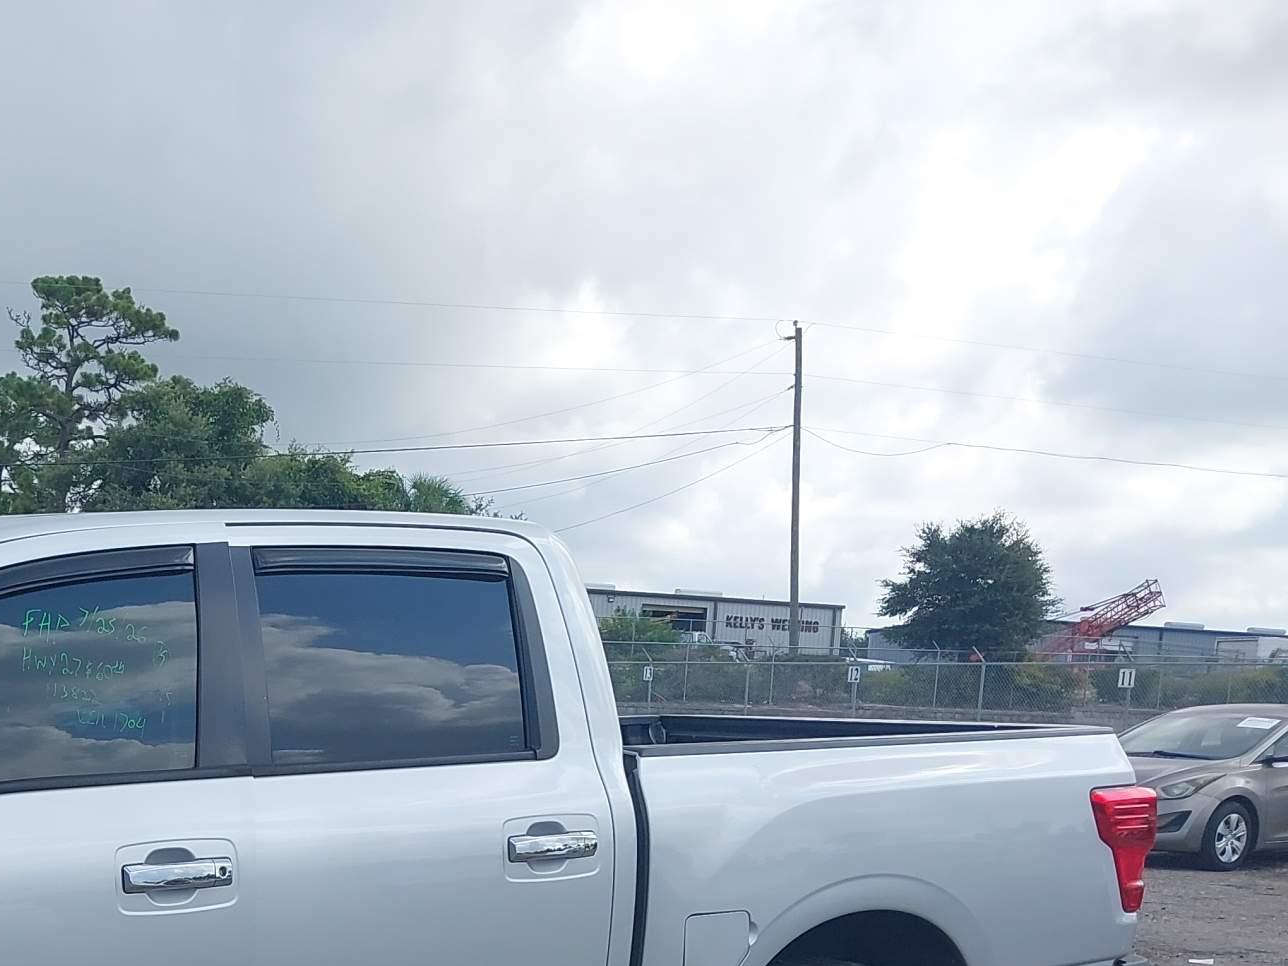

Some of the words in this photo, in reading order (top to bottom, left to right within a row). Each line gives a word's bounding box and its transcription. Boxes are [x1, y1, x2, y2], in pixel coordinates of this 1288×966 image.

[725, 615, 765, 630] KELLY'S
[771, 618, 819, 633] WEING
[849, 667, 859, 681] 12
[1121, 671, 1132, 686] 11
